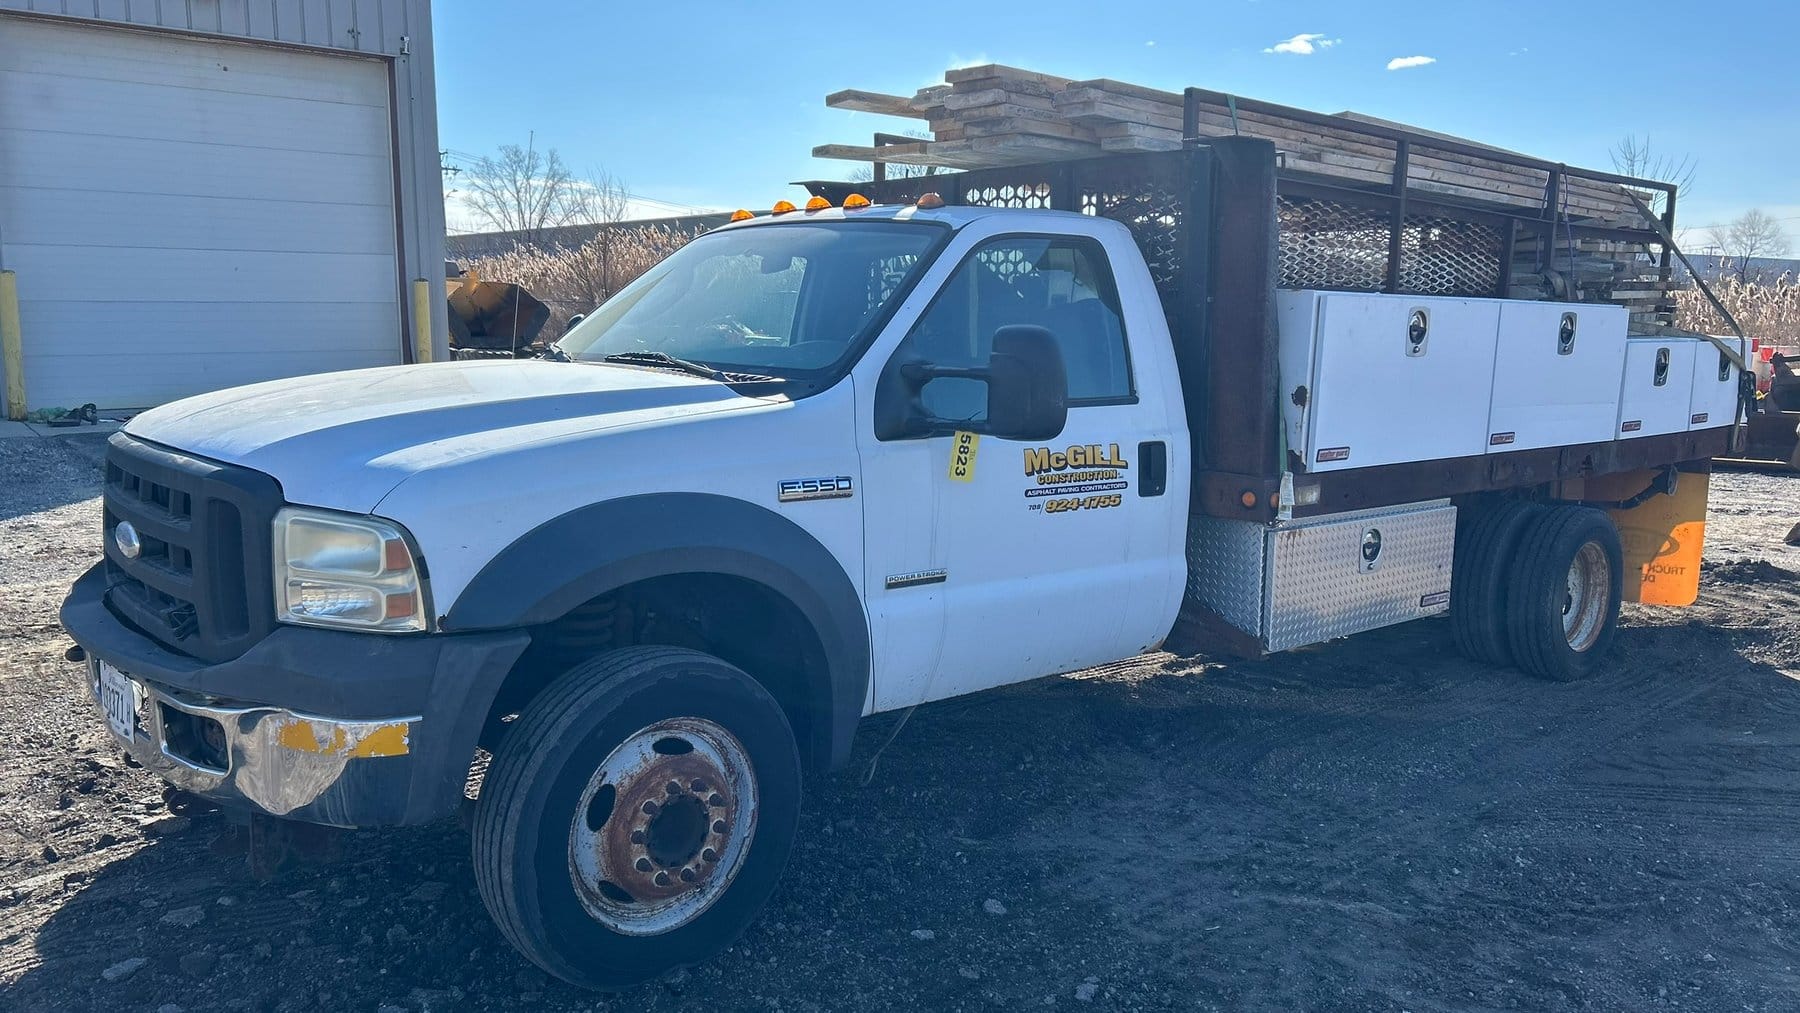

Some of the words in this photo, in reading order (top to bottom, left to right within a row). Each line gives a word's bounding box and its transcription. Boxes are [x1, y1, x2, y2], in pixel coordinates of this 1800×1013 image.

[955, 433, 971, 477] 5823
[1023, 443, 1128, 477] McGILL
[1036, 469, 1118, 485] CONSTRUCTION
[1027, 488, 1056, 497] ASPHALT
[1057, 486, 1080, 494] PAVING
[1080, 482, 1127, 493] CONTRACTORS
[1045, 493, 1122, 513] 924-1755
[888, 573, 916, 582] POWER
